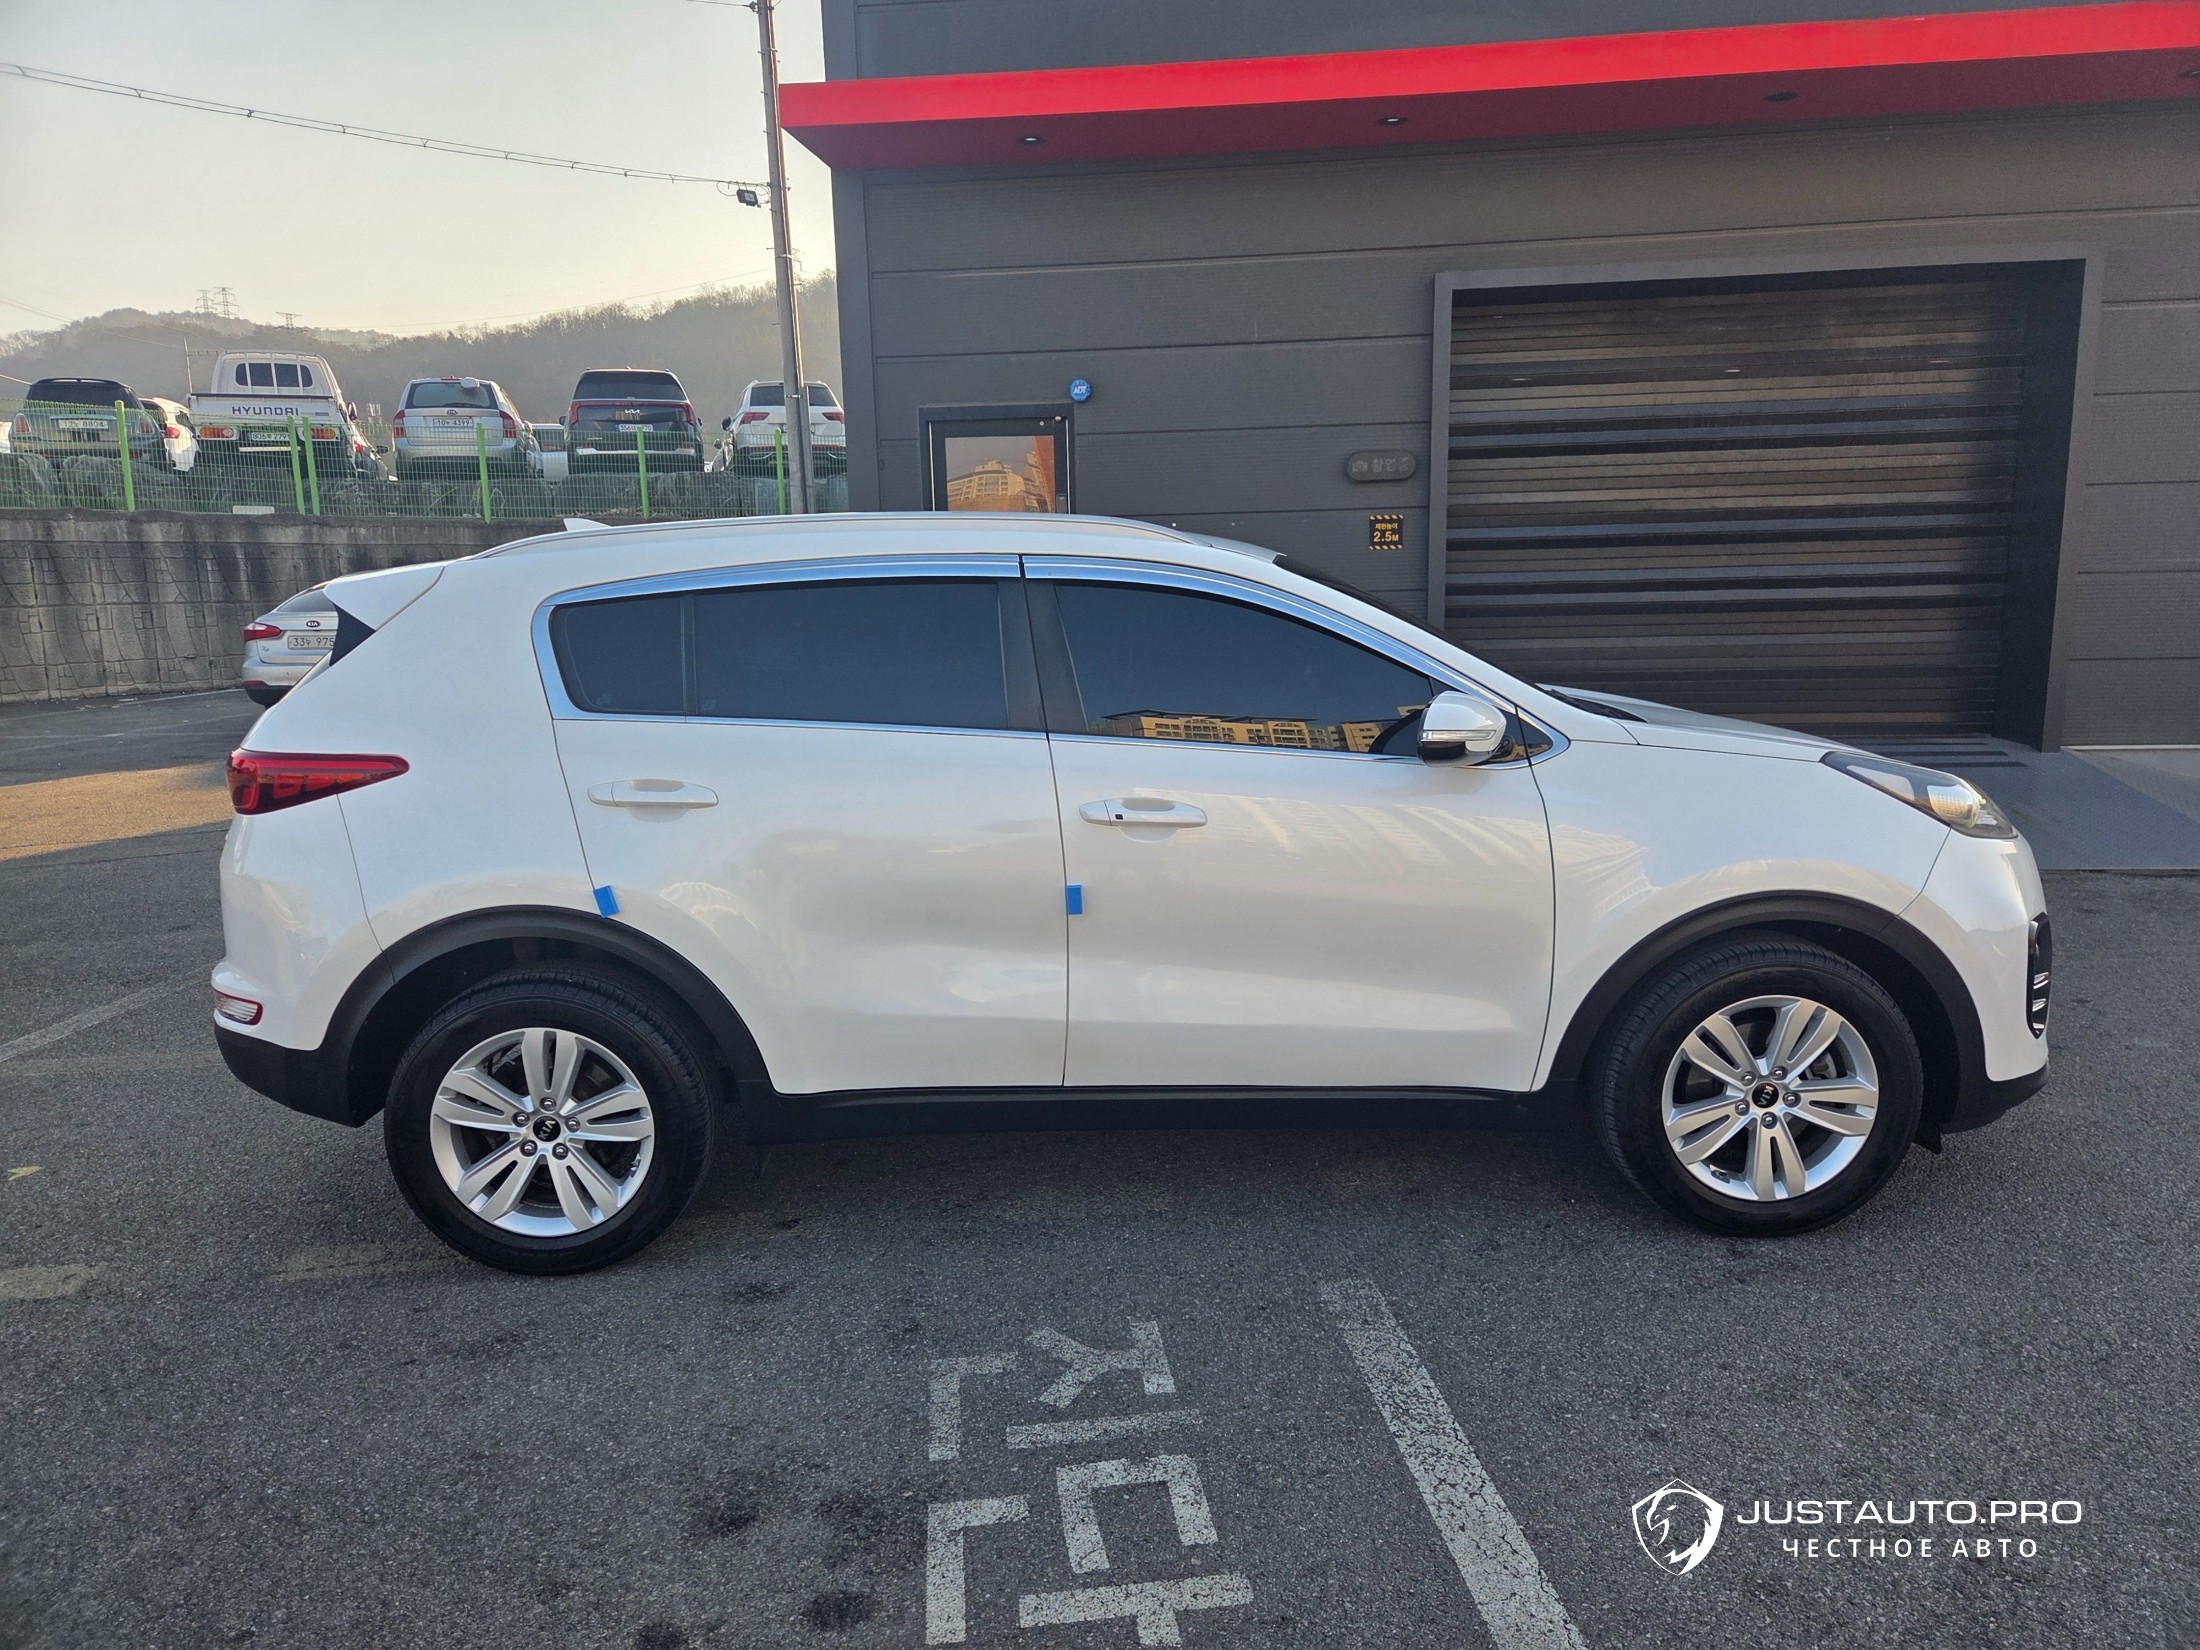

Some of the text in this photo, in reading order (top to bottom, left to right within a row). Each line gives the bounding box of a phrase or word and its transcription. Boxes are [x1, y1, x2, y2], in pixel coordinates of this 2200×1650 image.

[1073, 385, 1087, 394] ADT
[232, 406, 299, 416] HYUNDAI
[316, 637, 336, 647] 975
[1758, 1085, 1774, 1105] KIA
[538, 1120, 556, 1140] KIA
